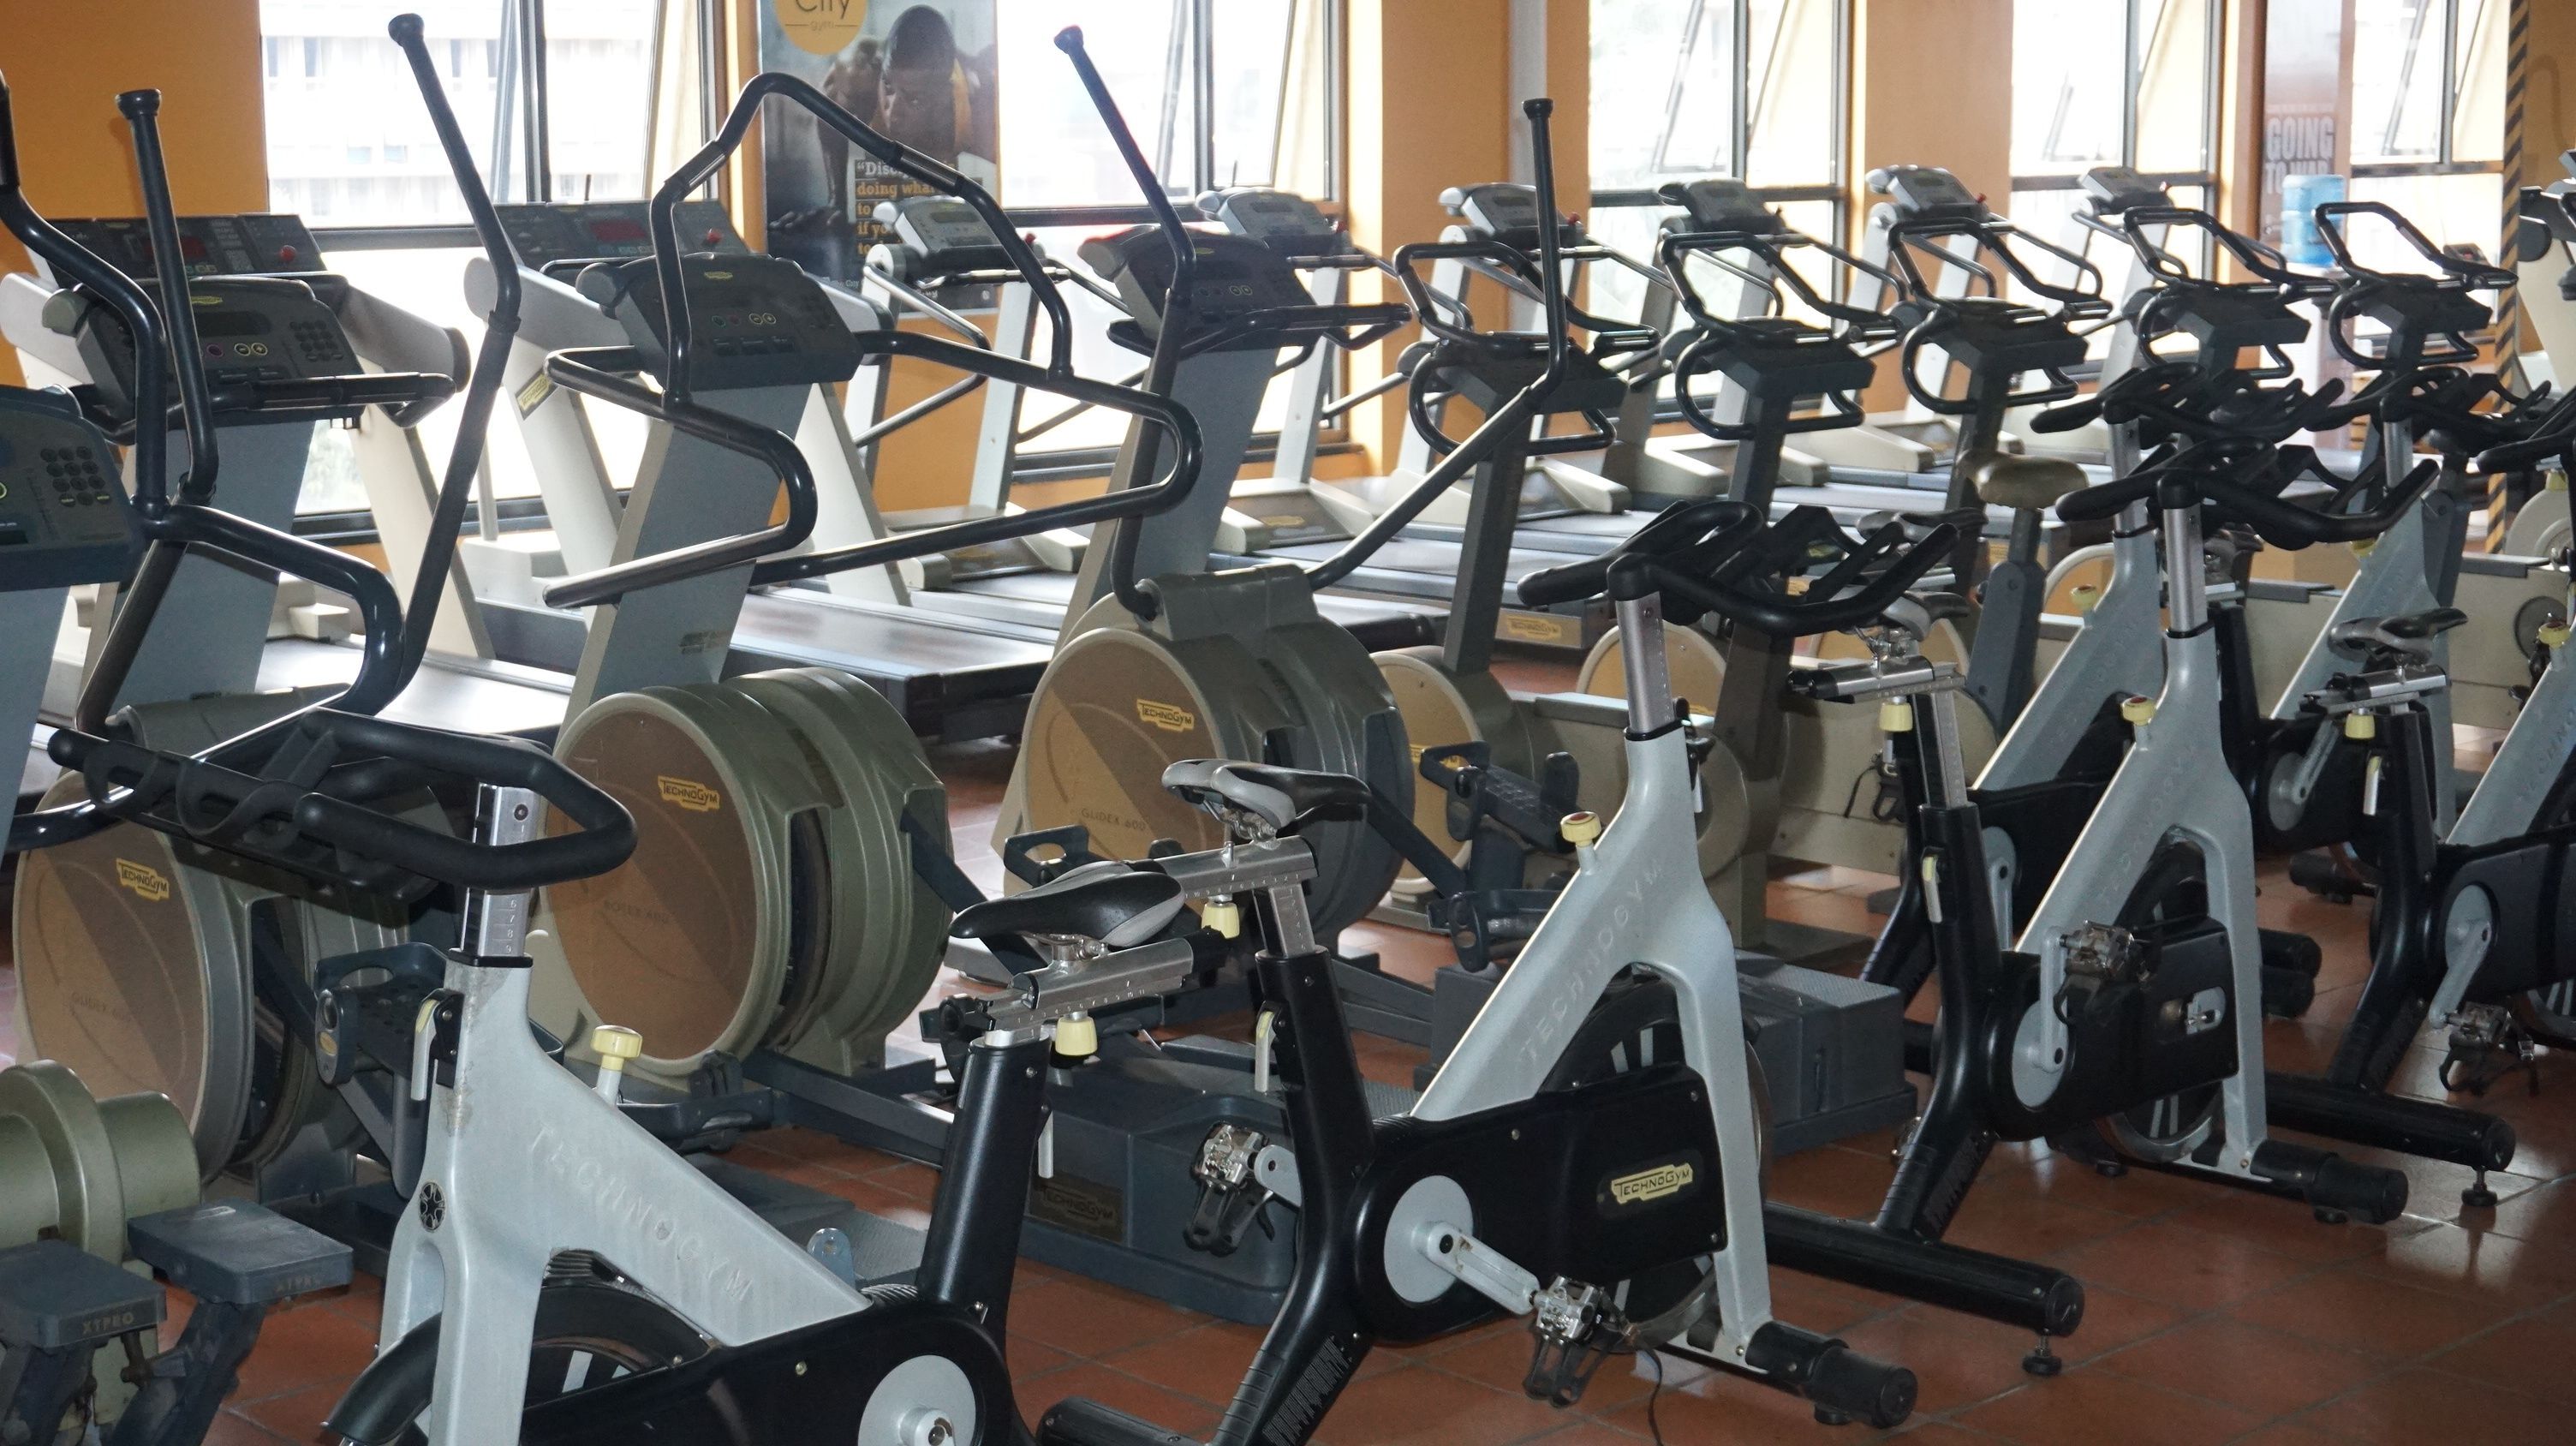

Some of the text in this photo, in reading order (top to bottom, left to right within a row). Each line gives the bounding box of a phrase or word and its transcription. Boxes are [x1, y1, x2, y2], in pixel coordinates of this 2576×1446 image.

[2267, 116, 2334, 160] GOING
[857, 182, 897, 200] doing
[858, 202, 871, 215] to
[871, 224, 888, 239] yo
[659, 779, 718, 805] TECHNOGYM
[1613, 1170, 1690, 1198] TECHNOGYM
[529, 1120, 754, 1302] TECHNOGYM
